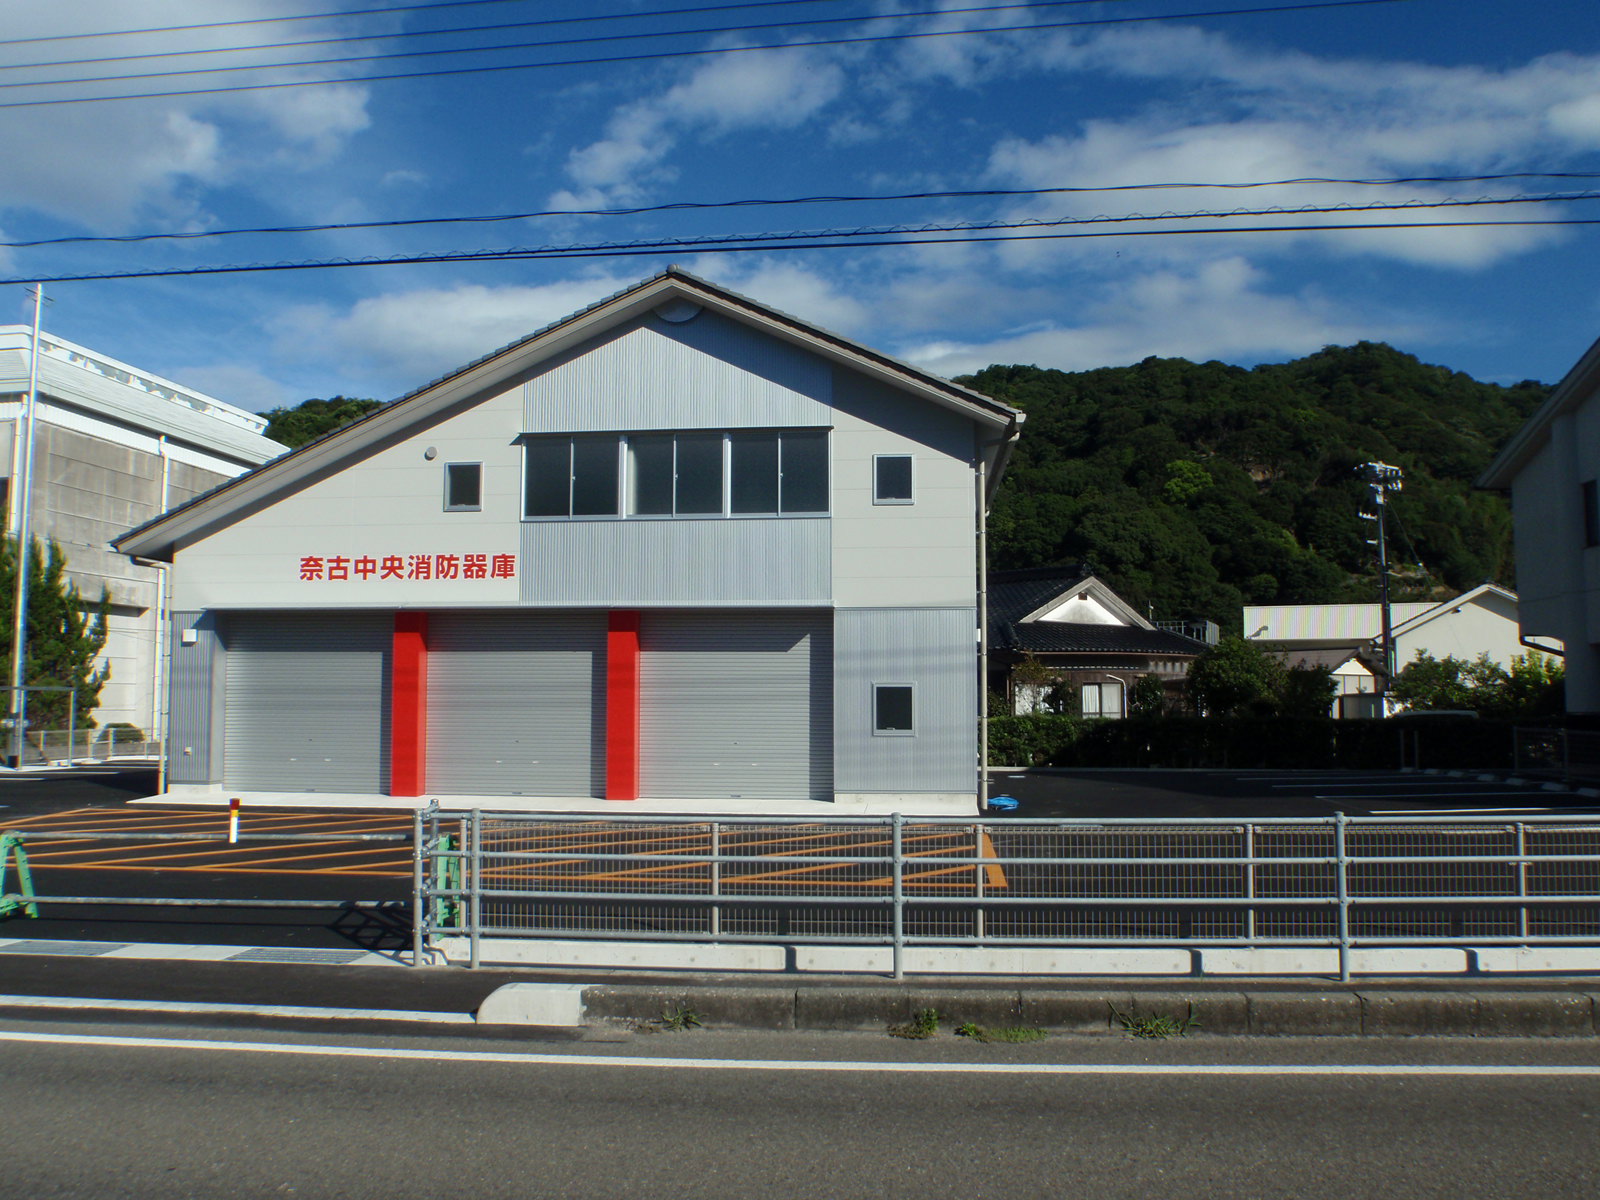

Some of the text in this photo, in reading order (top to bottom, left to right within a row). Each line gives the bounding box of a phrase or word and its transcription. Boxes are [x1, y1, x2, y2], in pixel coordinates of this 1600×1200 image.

[300, 554, 516, 581] 奈古中央消防器庫
